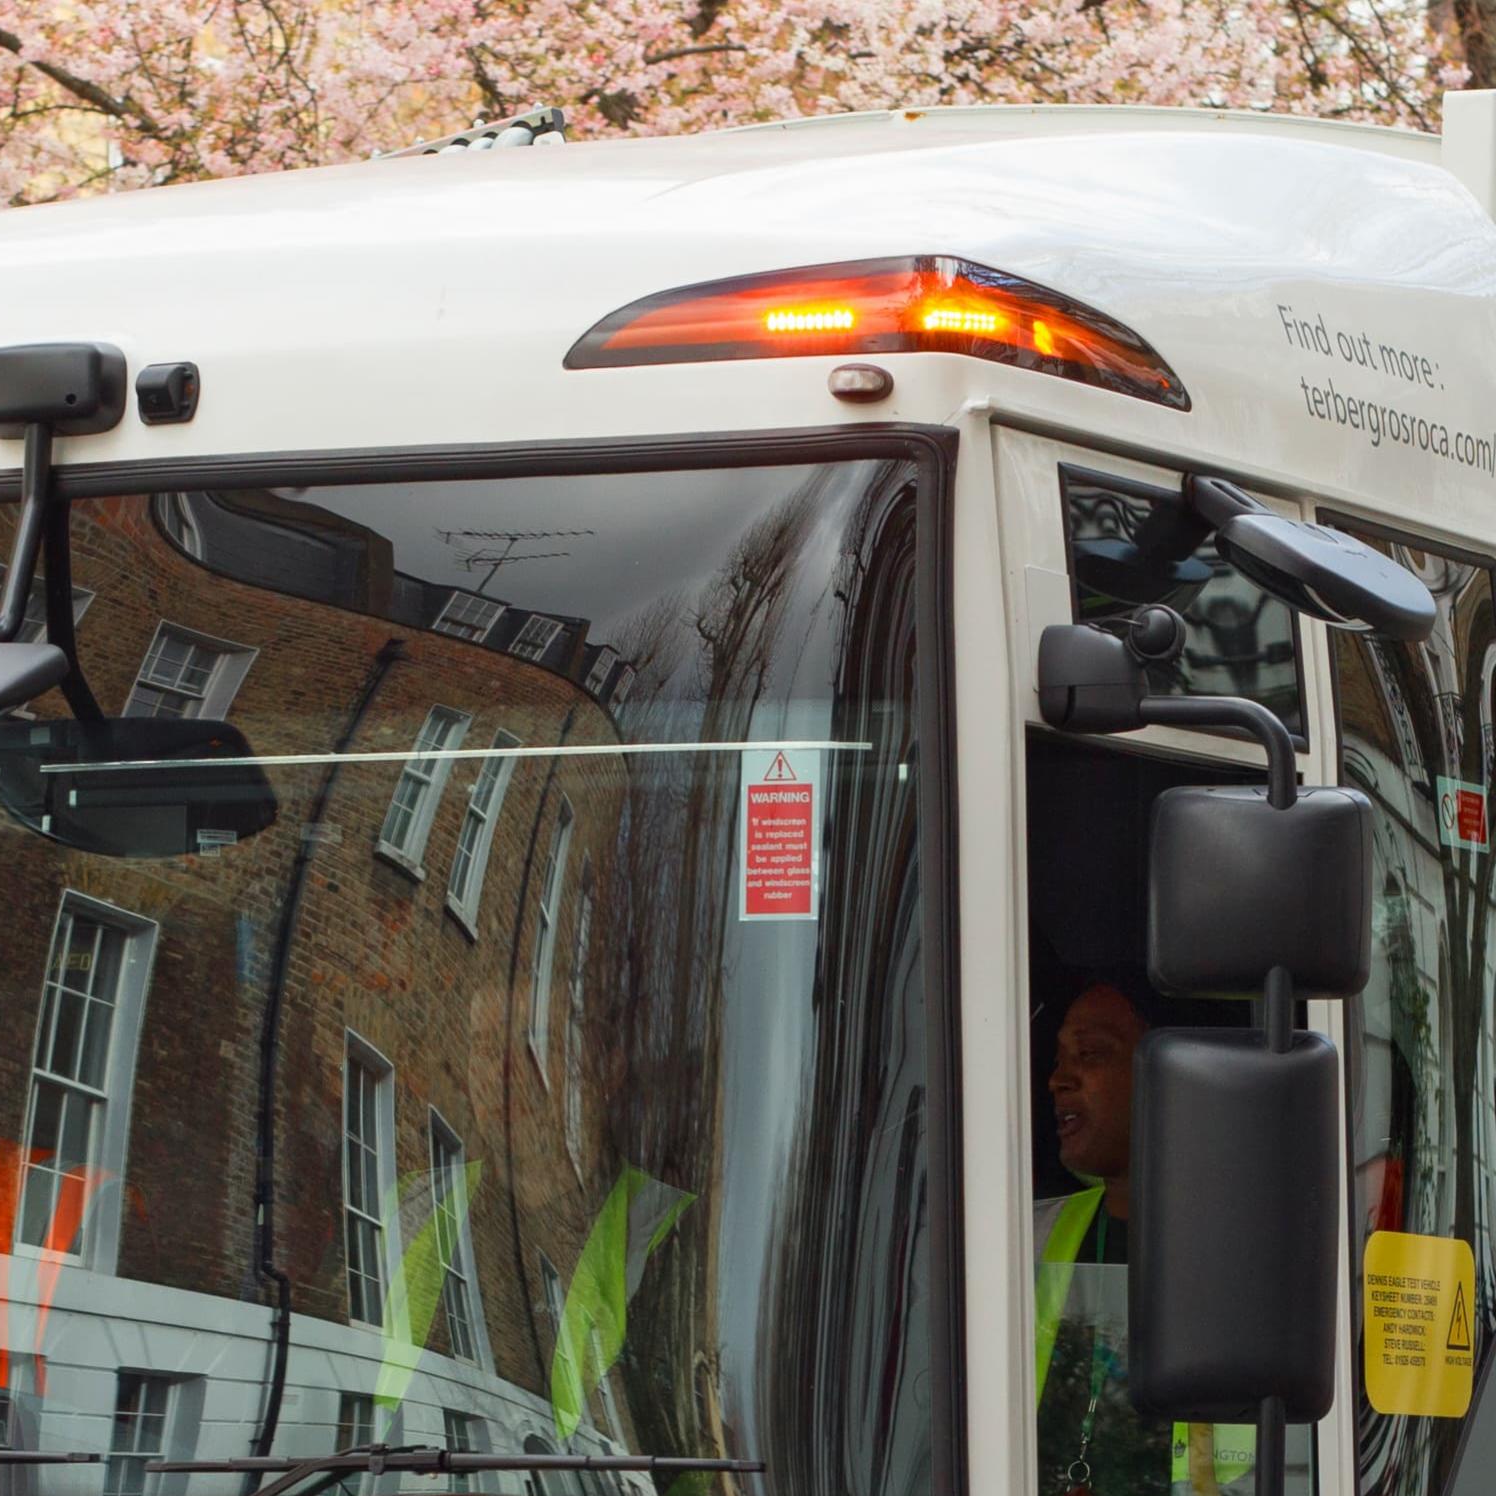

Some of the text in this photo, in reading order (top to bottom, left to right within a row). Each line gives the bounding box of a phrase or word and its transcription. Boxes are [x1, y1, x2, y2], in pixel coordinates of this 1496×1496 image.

[1278, 304, 1446, 391] Find out more:
[750, 791, 810, 804] WARNING
[761, 817, 808, 827] windscreen
[765, 829, 805, 841] replaced
[785, 842, 808, 851] must
[770, 854, 803, 866] applied
[764, 878, 810, 888] windscreen
[763, 890, 793, 901] rubber
